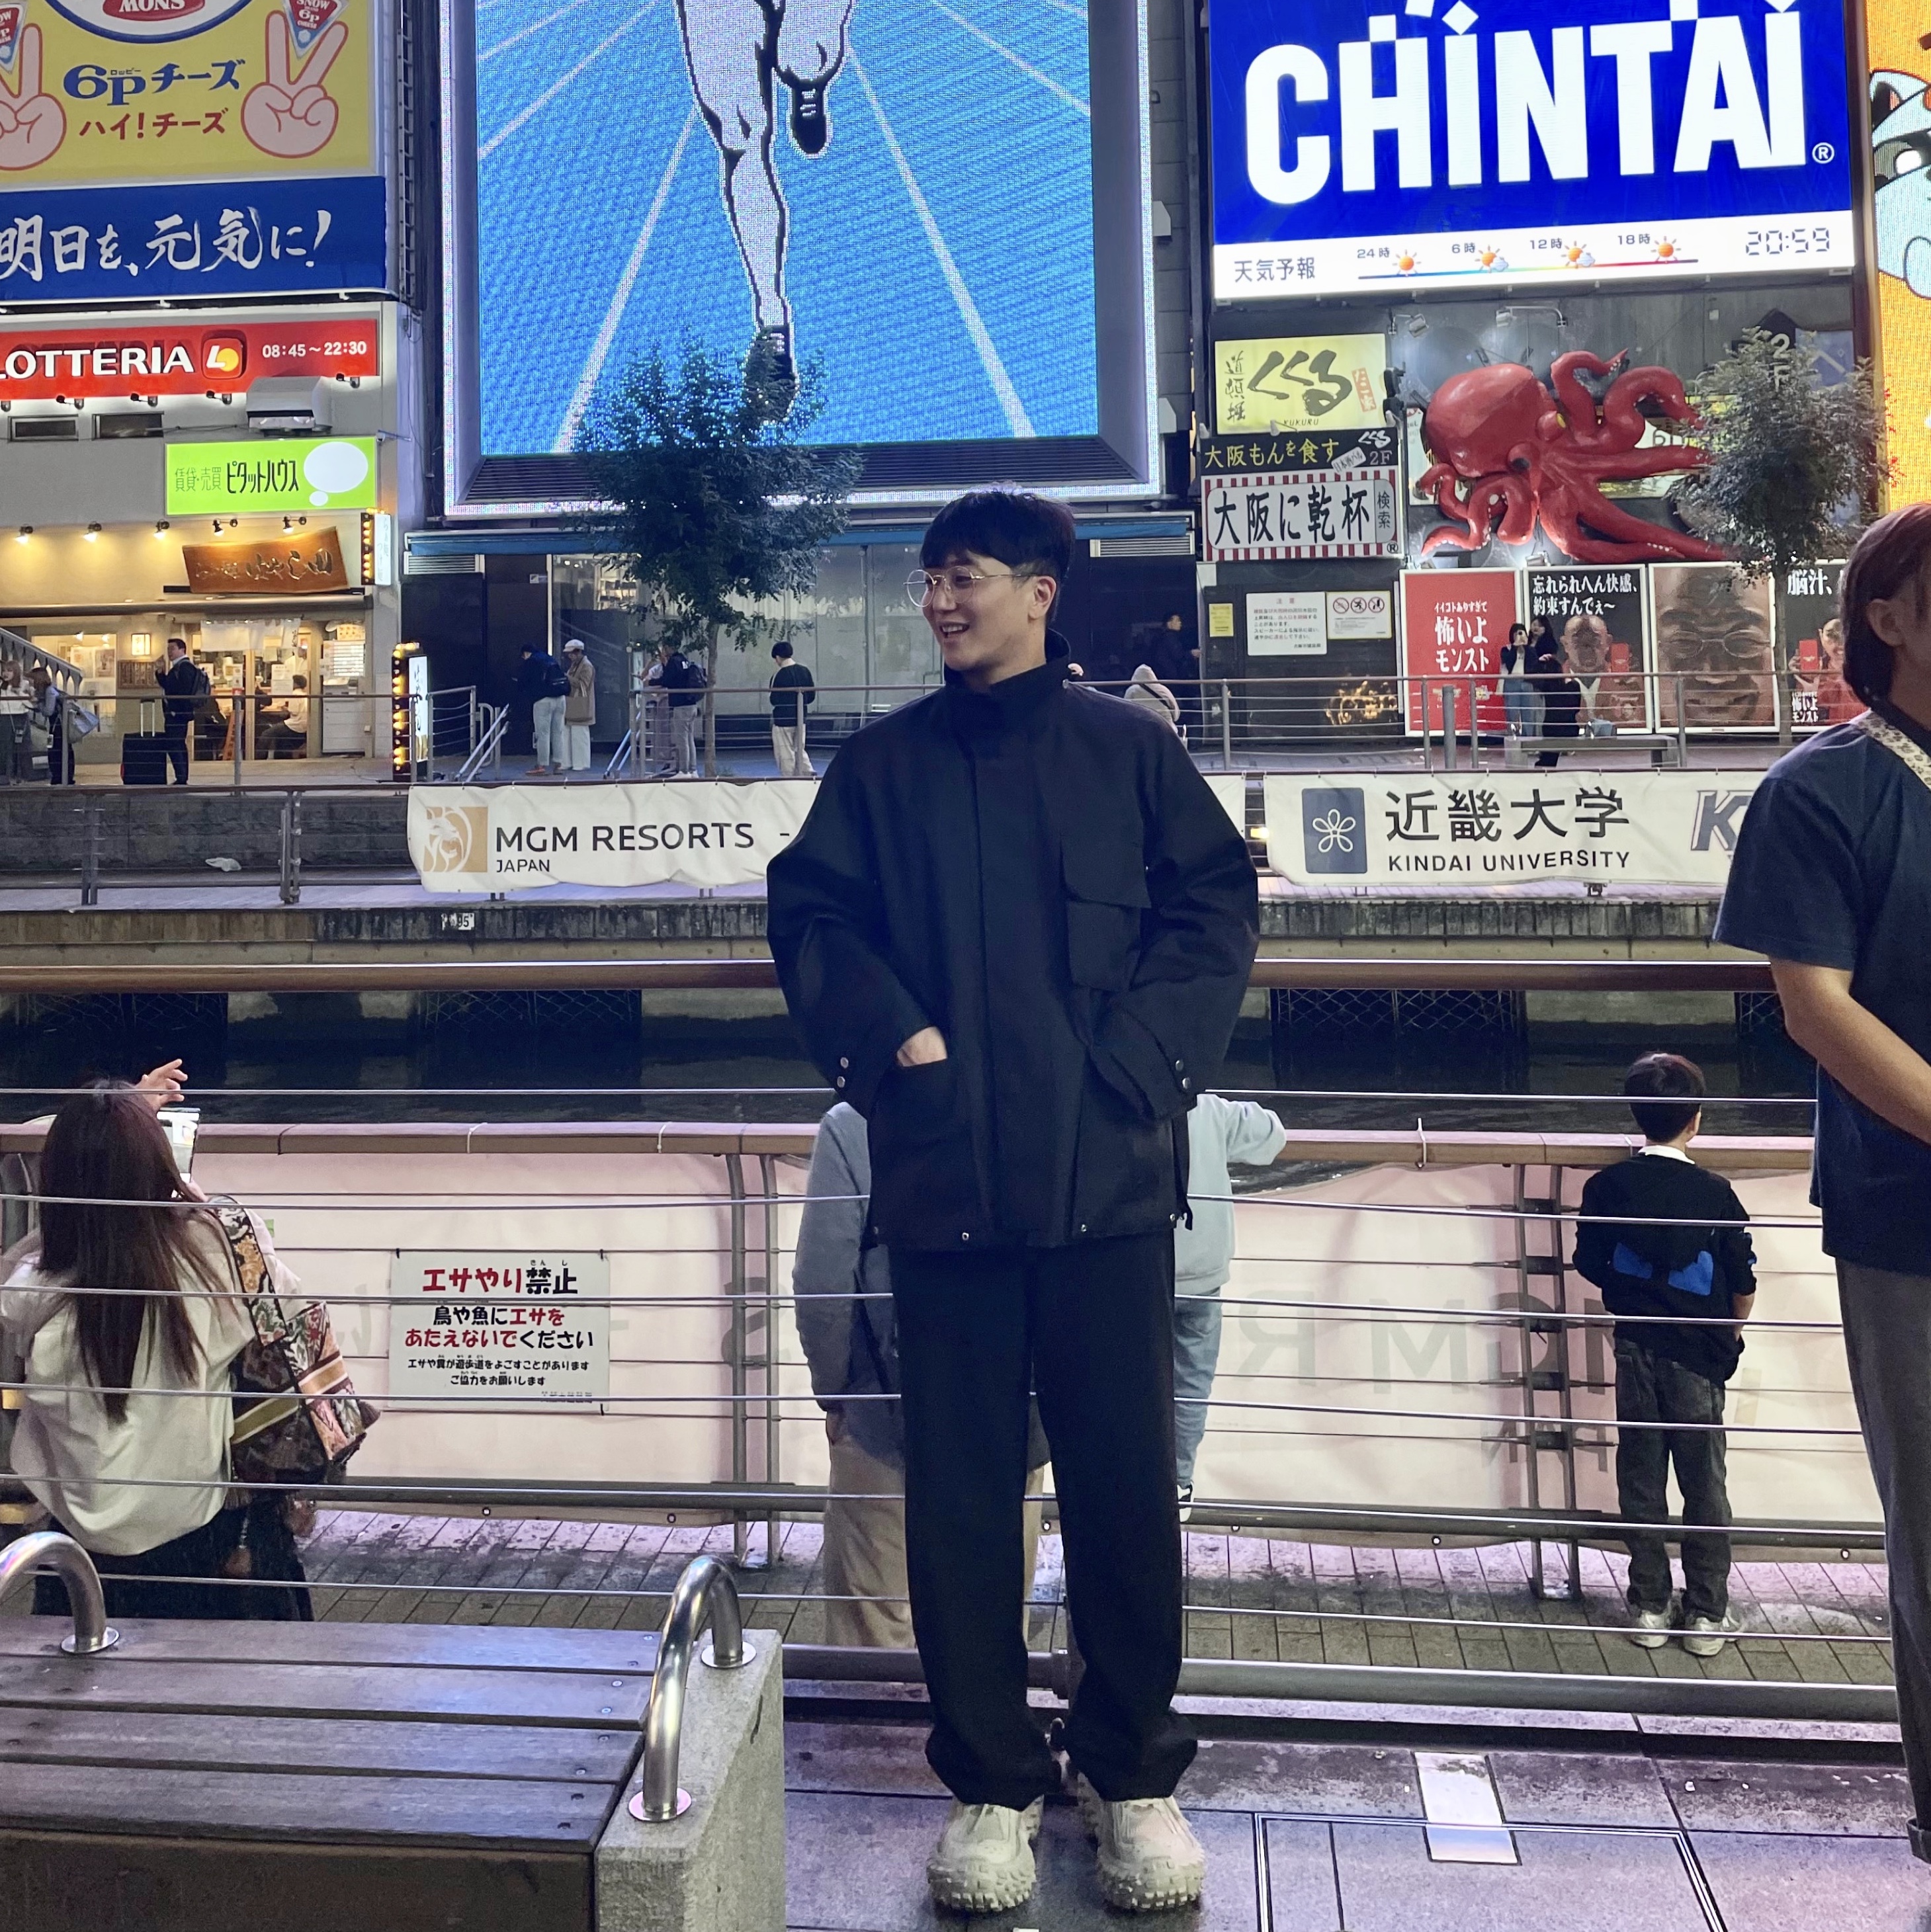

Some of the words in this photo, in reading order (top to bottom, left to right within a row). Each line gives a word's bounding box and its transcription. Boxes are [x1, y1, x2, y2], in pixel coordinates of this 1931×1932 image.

[1357, 247, 1390, 259] 24時
[1451, 242, 1477, 254] 6時
[1529, 237, 1563, 249] 12時
[1617, 233, 1651, 245] 18時
[1745, 227, 1830, 255] 20:59
[1234, 257, 1316, 282] 天気予報
[0, 346, 194, 380] OTTERIA
[1224, 351, 1246, 422] 道頓堀
[1247, 349, 1353, 416] くくる
[1283, 418, 1319, 427] KUKURU
[1205, 439, 1339, 468] 大阪もんを食す
[1369, 450, 1393, 465] 2F
[227, 458, 299, 493] ピタットハウス
[1215, 484, 1370, 545] 大阪に乾杯
[1377, 491, 1391, 529] 検索
[1532, 573, 1637, 594] 忘れられへん快感、
[1434, 616, 1488, 646] 怖いよ
[1435, 648, 1490, 673] モンスト
[1385, 786, 1630, 842] 近畿大学
[497, 826, 578, 853] MGM
[593, 823, 754, 851] RESORTS
[497, 859, 550, 873] JAPAN
[1389, 856, 1471, 872] KINDAI
[1483, 851, 1631, 871] UNIVERSITY
[422, 1267, 578, 1294] エサやり禁止
[433, 1306, 565, 1327] 鳥や魚にエサを
[405, 1328, 593, 1349] あたえないでください
